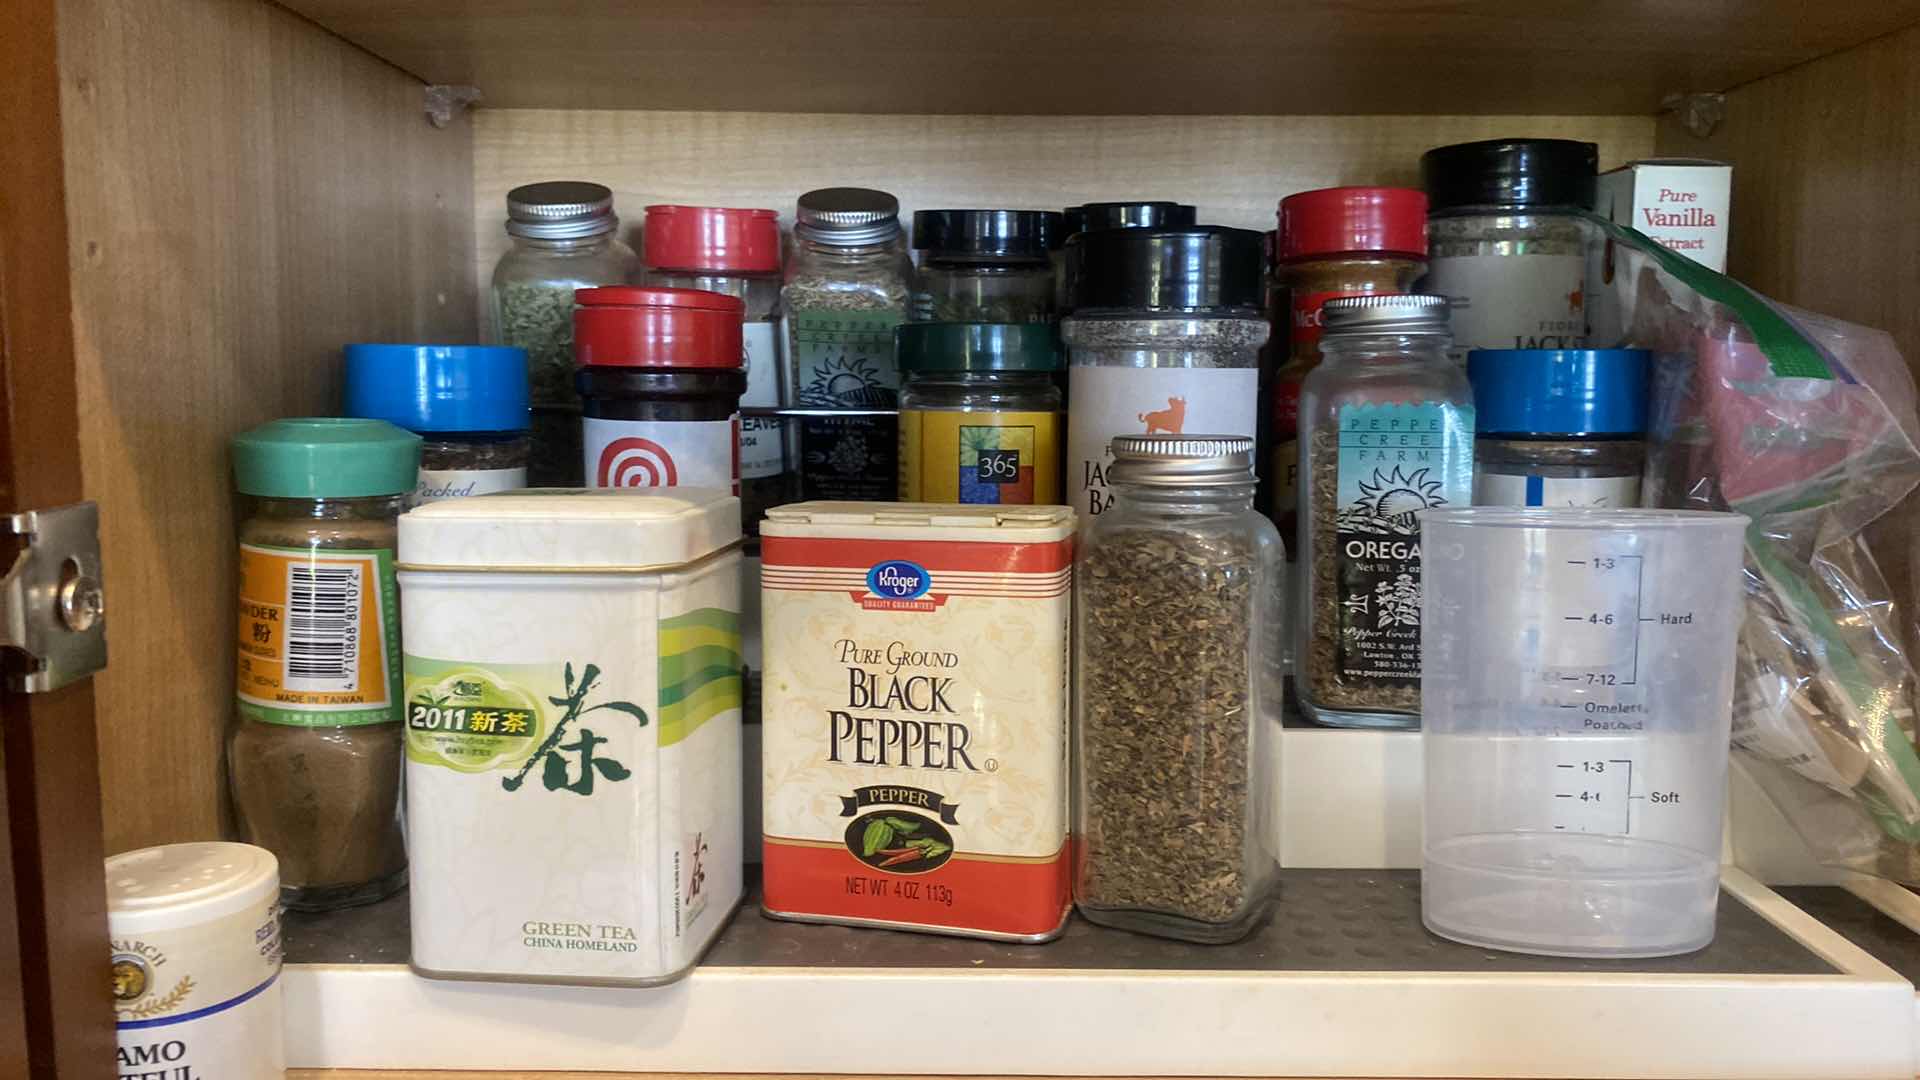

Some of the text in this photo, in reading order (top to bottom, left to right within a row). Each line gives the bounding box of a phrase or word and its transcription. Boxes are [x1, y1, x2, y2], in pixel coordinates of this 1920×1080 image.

[1658, 188, 1697, 202] Pure
[1643, 208, 1716, 227] Vanilla
[1351, 418, 1439, 431] PEPPE
[1359, 434, 1431, 446] CREE
[1359, 450, 1431, 462] FARM
[980, 453, 1018, 478] 365
[416, 481, 477, 497] Packed
[1356, 562, 1374, 573] Net
[1593, 558, 1615, 570] 1-3
[879, 566, 921, 596] Kroger
[863, 599, 890, 609] QUALITY
[1589, 613, 1614, 625] 4-6
[1660, 613, 1693, 625] Hard
[1586, 674, 1616, 686] 7-12
[848, 667, 956, 713] BLACK
[276, 693, 365, 704] MADE IN TAIWAN
[411, 706, 468, 731] 2011
[469, 710, 529, 734] 新茶
[826, 710, 981, 772] PEPPER
[1583, 761, 1604, 773] 1-3
[869, 787, 929, 807] PEPPER
[1651, 792, 1680, 803] Soft
[845, 876, 953, 906] NET WT 4 OZ 113g
[522, 920, 637, 940] GREEN TEA
[523, 936, 638, 953] CHINA HOMELAND
